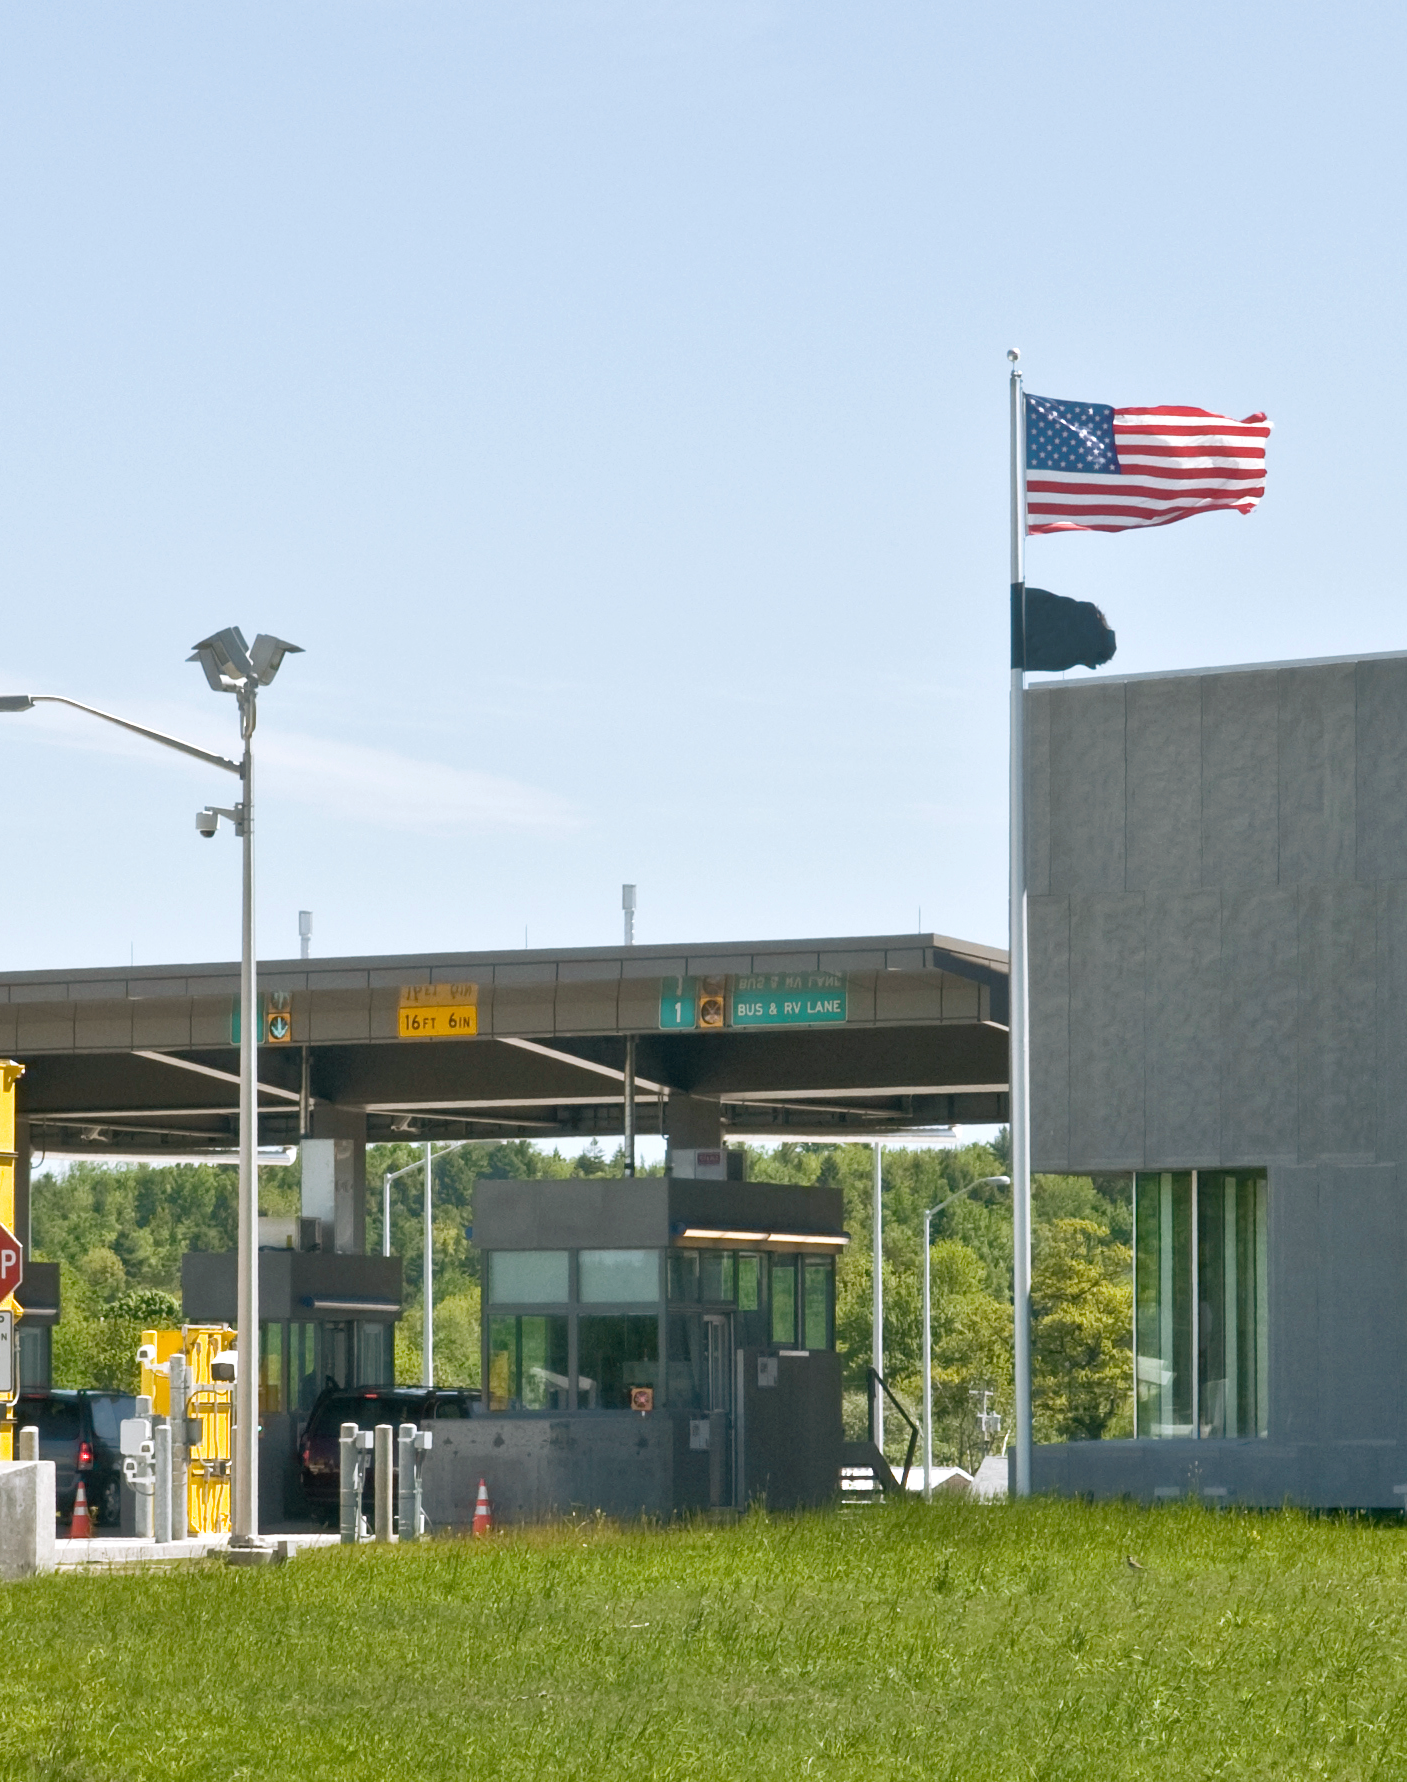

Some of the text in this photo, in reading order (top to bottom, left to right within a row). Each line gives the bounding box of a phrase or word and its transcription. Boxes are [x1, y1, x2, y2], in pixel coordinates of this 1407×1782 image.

[674, 1002, 682, 1023] 1
[737, 1000, 841, 1016] BUS & RV LANE
